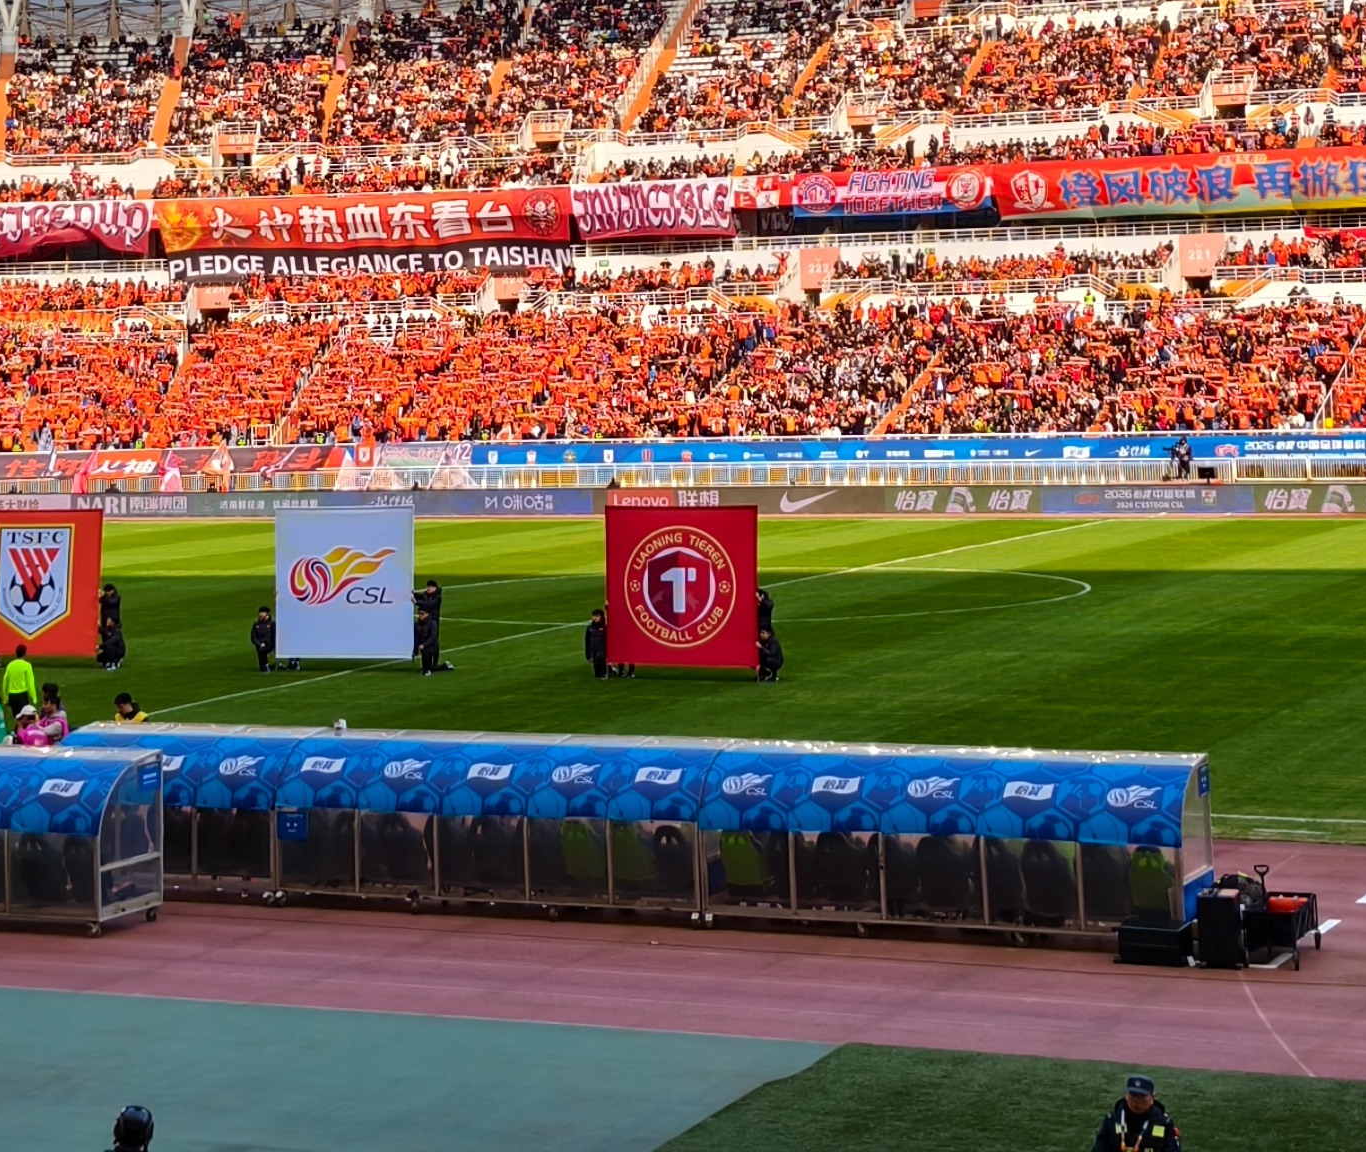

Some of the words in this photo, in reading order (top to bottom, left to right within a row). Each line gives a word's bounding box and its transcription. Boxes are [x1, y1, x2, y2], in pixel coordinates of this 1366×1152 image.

[848, 168, 937, 194] FIGHTING
[842, 193, 943, 214] TOGETHER
[209, 199, 515, 245] 火神热血东看台
[1188, 249, 1211, 261] 221
[169, 254, 265, 280] PLEDGE
[272, 252, 423, 276] ALLEGIANCE
[429, 250, 463, 271] TO
[469, 245, 573, 268] TAISHAN
[808, 263, 830, 274] 222
[1244, 441, 1275, 451] 2026
[613, 493, 669, 507] Lenovo
[1104, 489, 1132, 500] 2026
[76, 496, 127, 514] NARI
[6, 531, 64, 545] TSFC
[632, 532, 683, 570] LIAONING
[689, 534, 726, 570] TIEREN
[345, 585, 394, 605] CSL
[635, 604, 693, 642] FOOTBALL
[697, 605, 725, 636] CLUB
[238, 769, 257, 777] CSL
[404, 772, 424, 780] CSL
[574, 776, 595, 784] CSL
[745, 787, 767, 796] CSL
[932, 790, 955, 799] CSL
[1133, 800, 1158, 809] CSL
